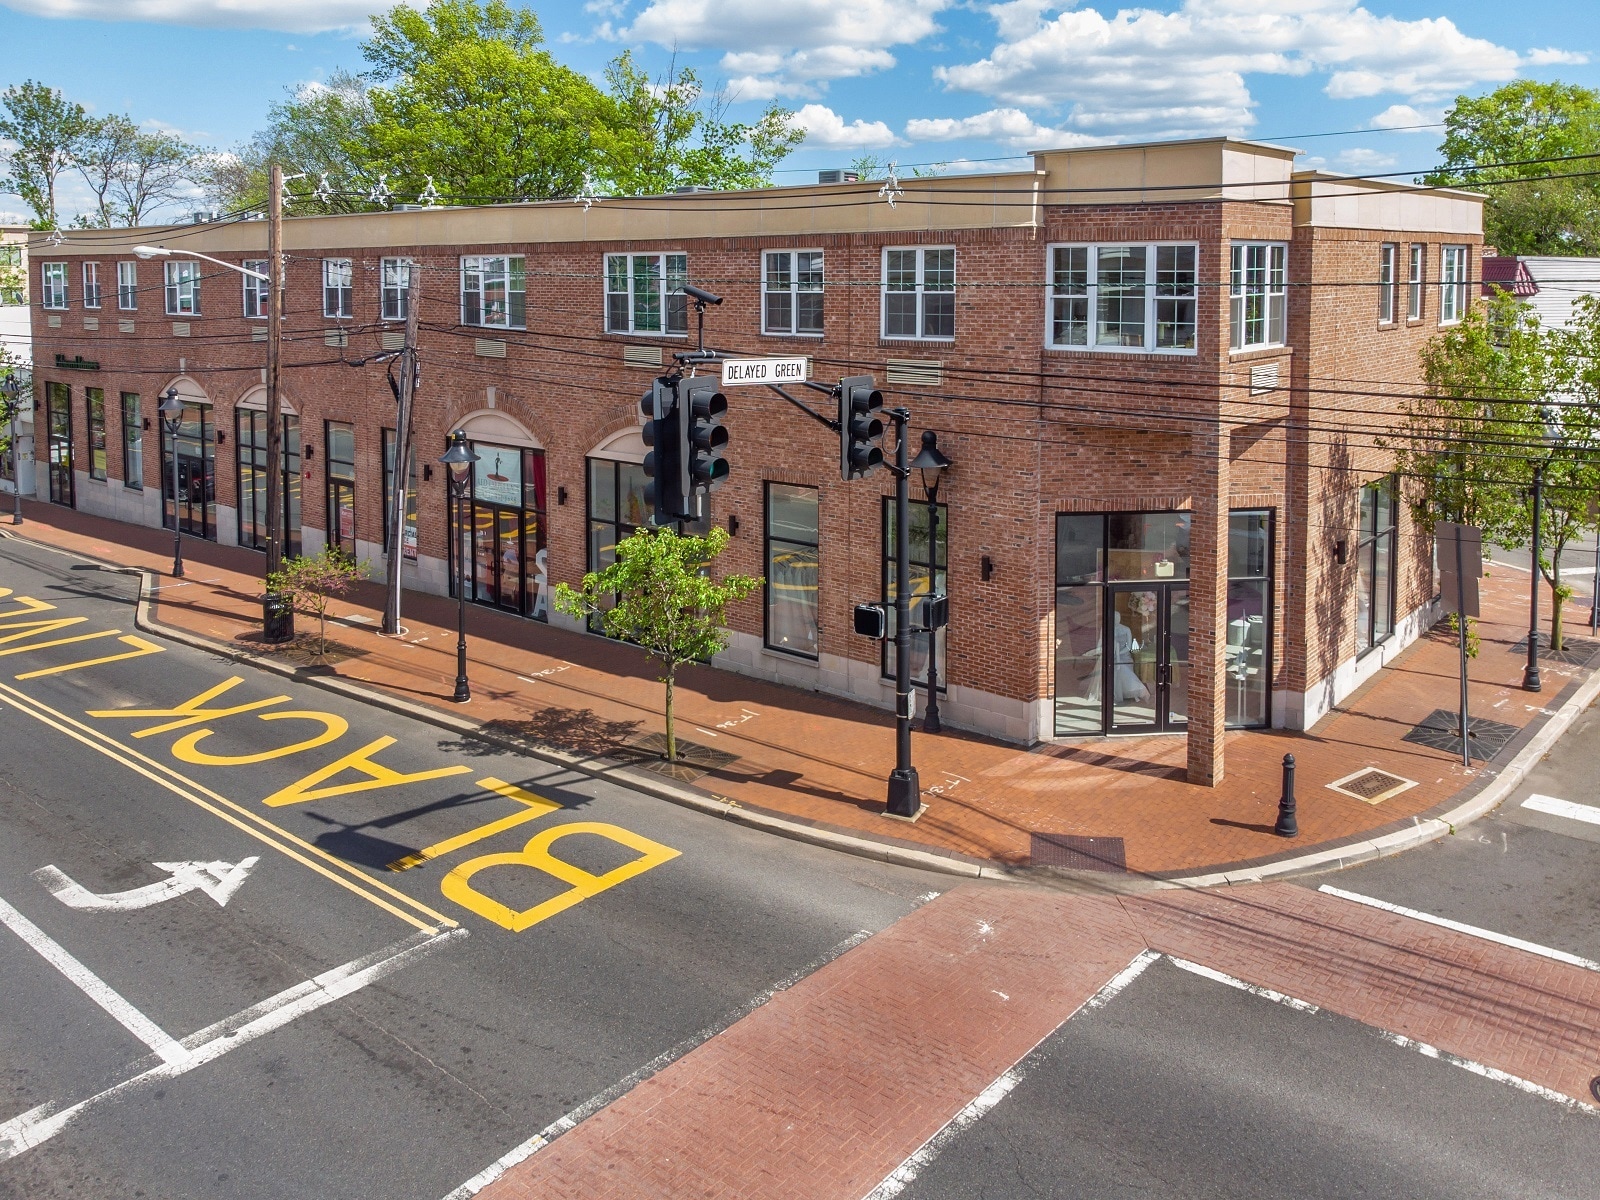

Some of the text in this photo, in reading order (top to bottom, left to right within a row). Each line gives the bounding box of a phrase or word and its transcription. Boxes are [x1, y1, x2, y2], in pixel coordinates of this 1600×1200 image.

[728, 363, 802, 380] DELAYED GREEN
[0, 587, 682, 932] BLACK LIV
